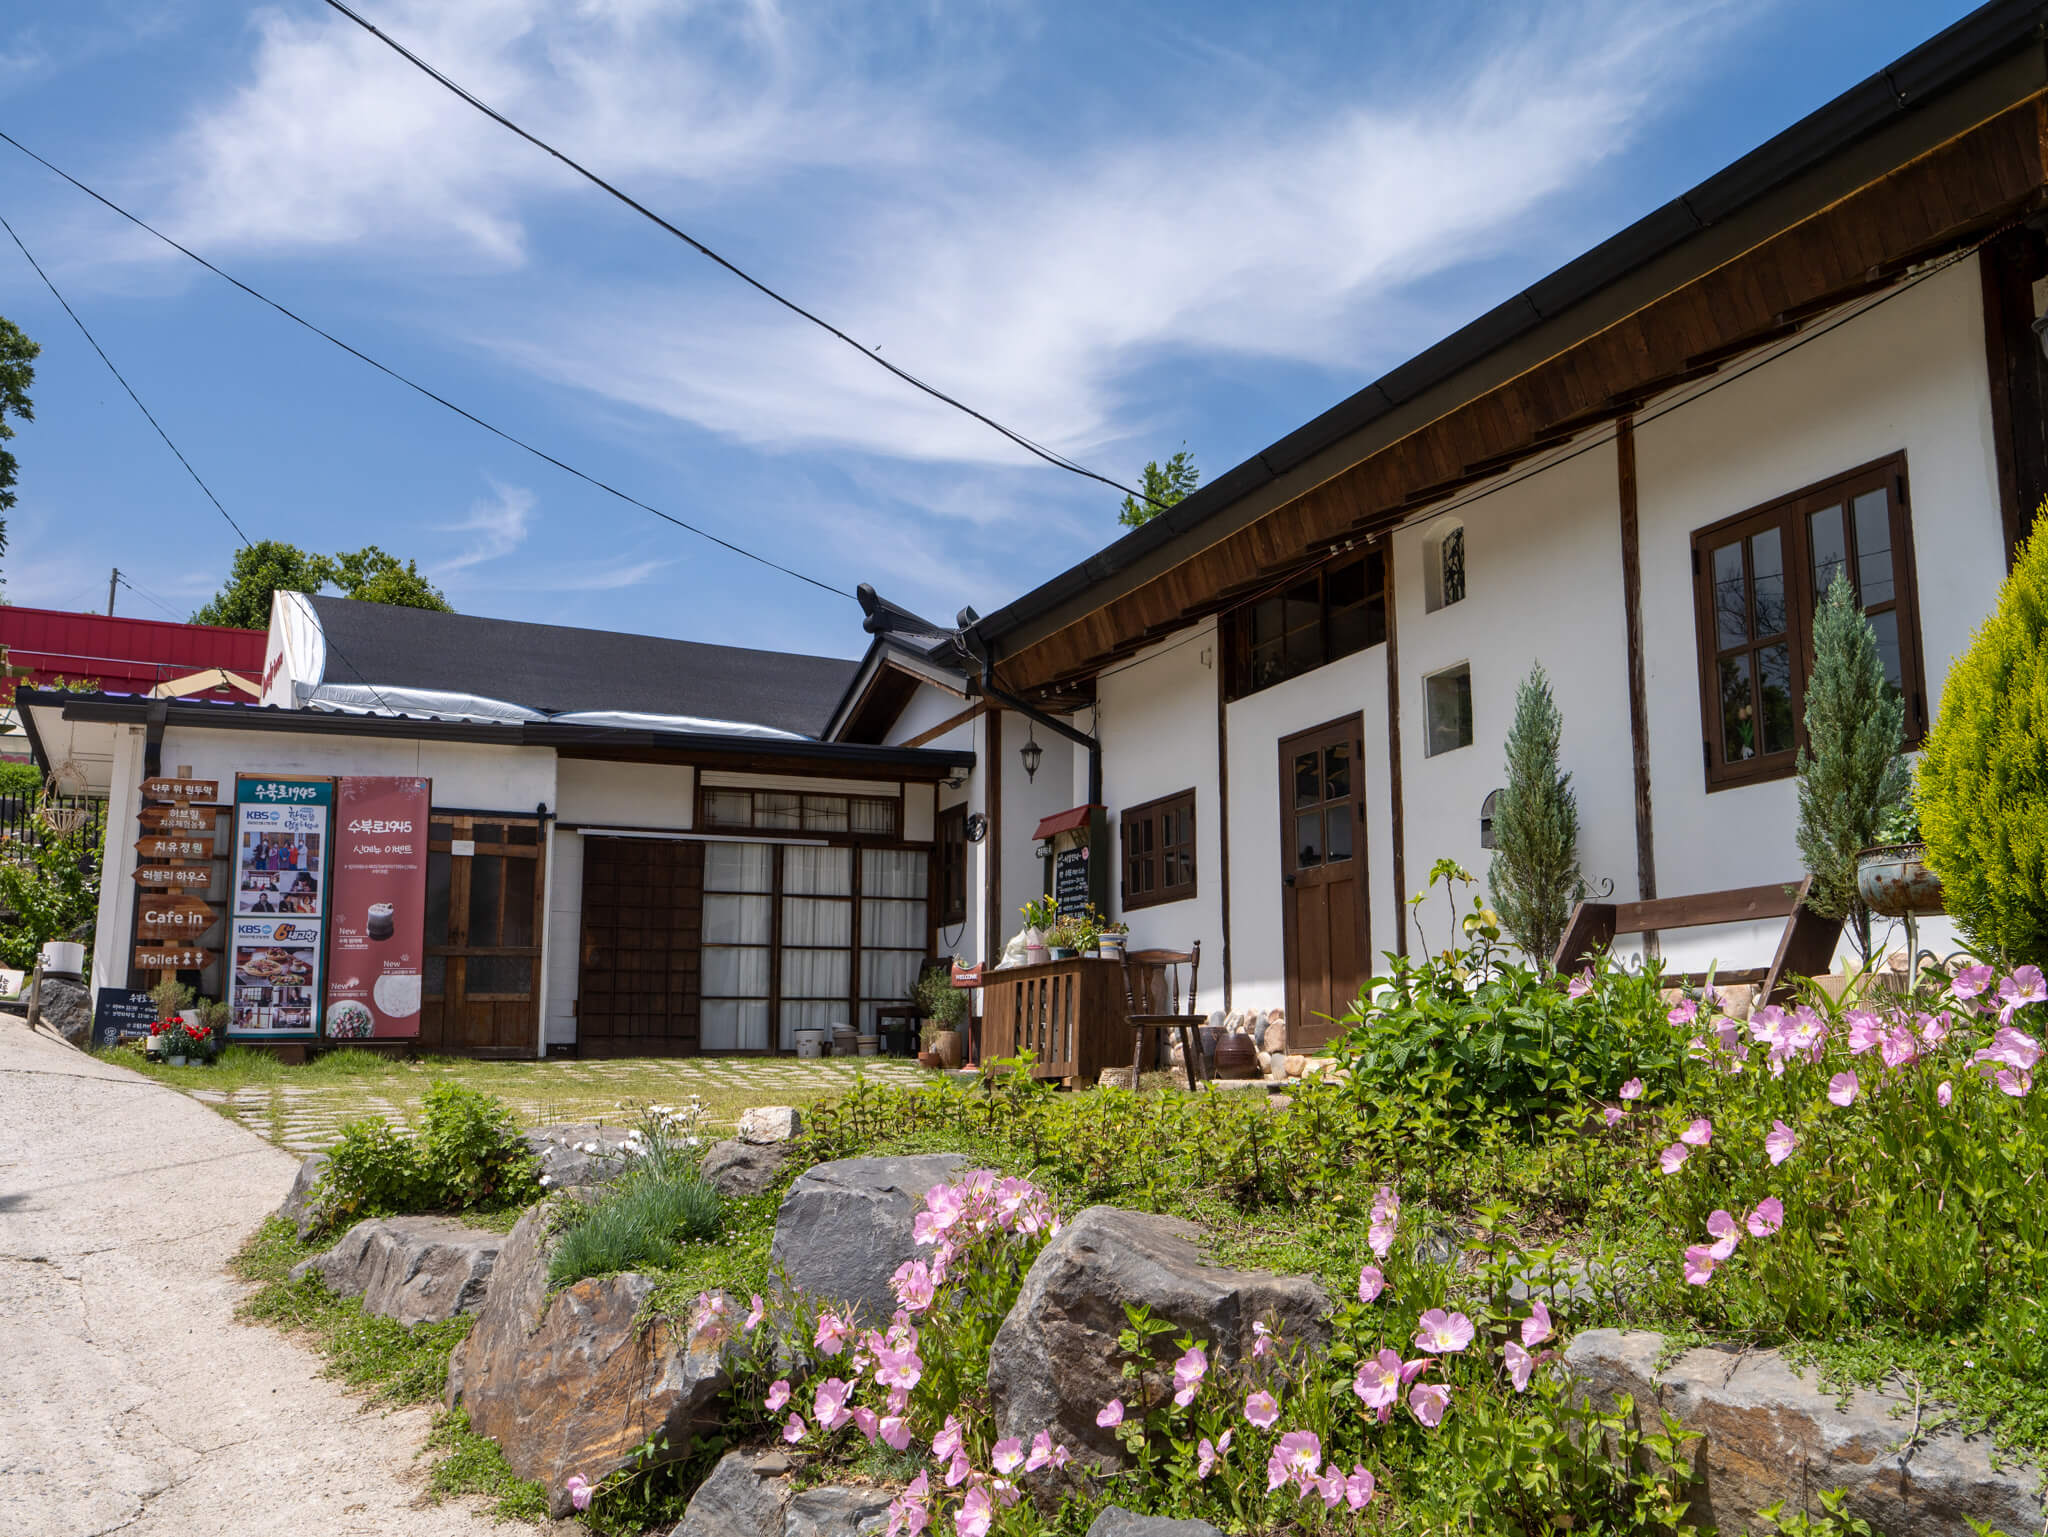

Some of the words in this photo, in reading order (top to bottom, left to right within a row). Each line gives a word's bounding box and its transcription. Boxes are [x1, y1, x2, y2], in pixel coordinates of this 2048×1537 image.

[151, 783, 170, 793] 나무
[173, 785, 182, 794] 위
[254, 783, 318, 802] 수북로1945
[246, 810, 270, 820] KBS
[347, 819, 413, 835] 수북로1945
[155, 841, 203, 854] 치유정원
[142, 870, 174, 882] 러블리
[176, 871, 208, 882] 하우스
[145, 910, 184, 924] Cafe
[188, 911, 203, 925] in
[238, 924, 261, 934] KBS
[339, 927, 357, 935] New
[141, 954, 179, 965] Toilet
[383, 960, 401, 968] New
